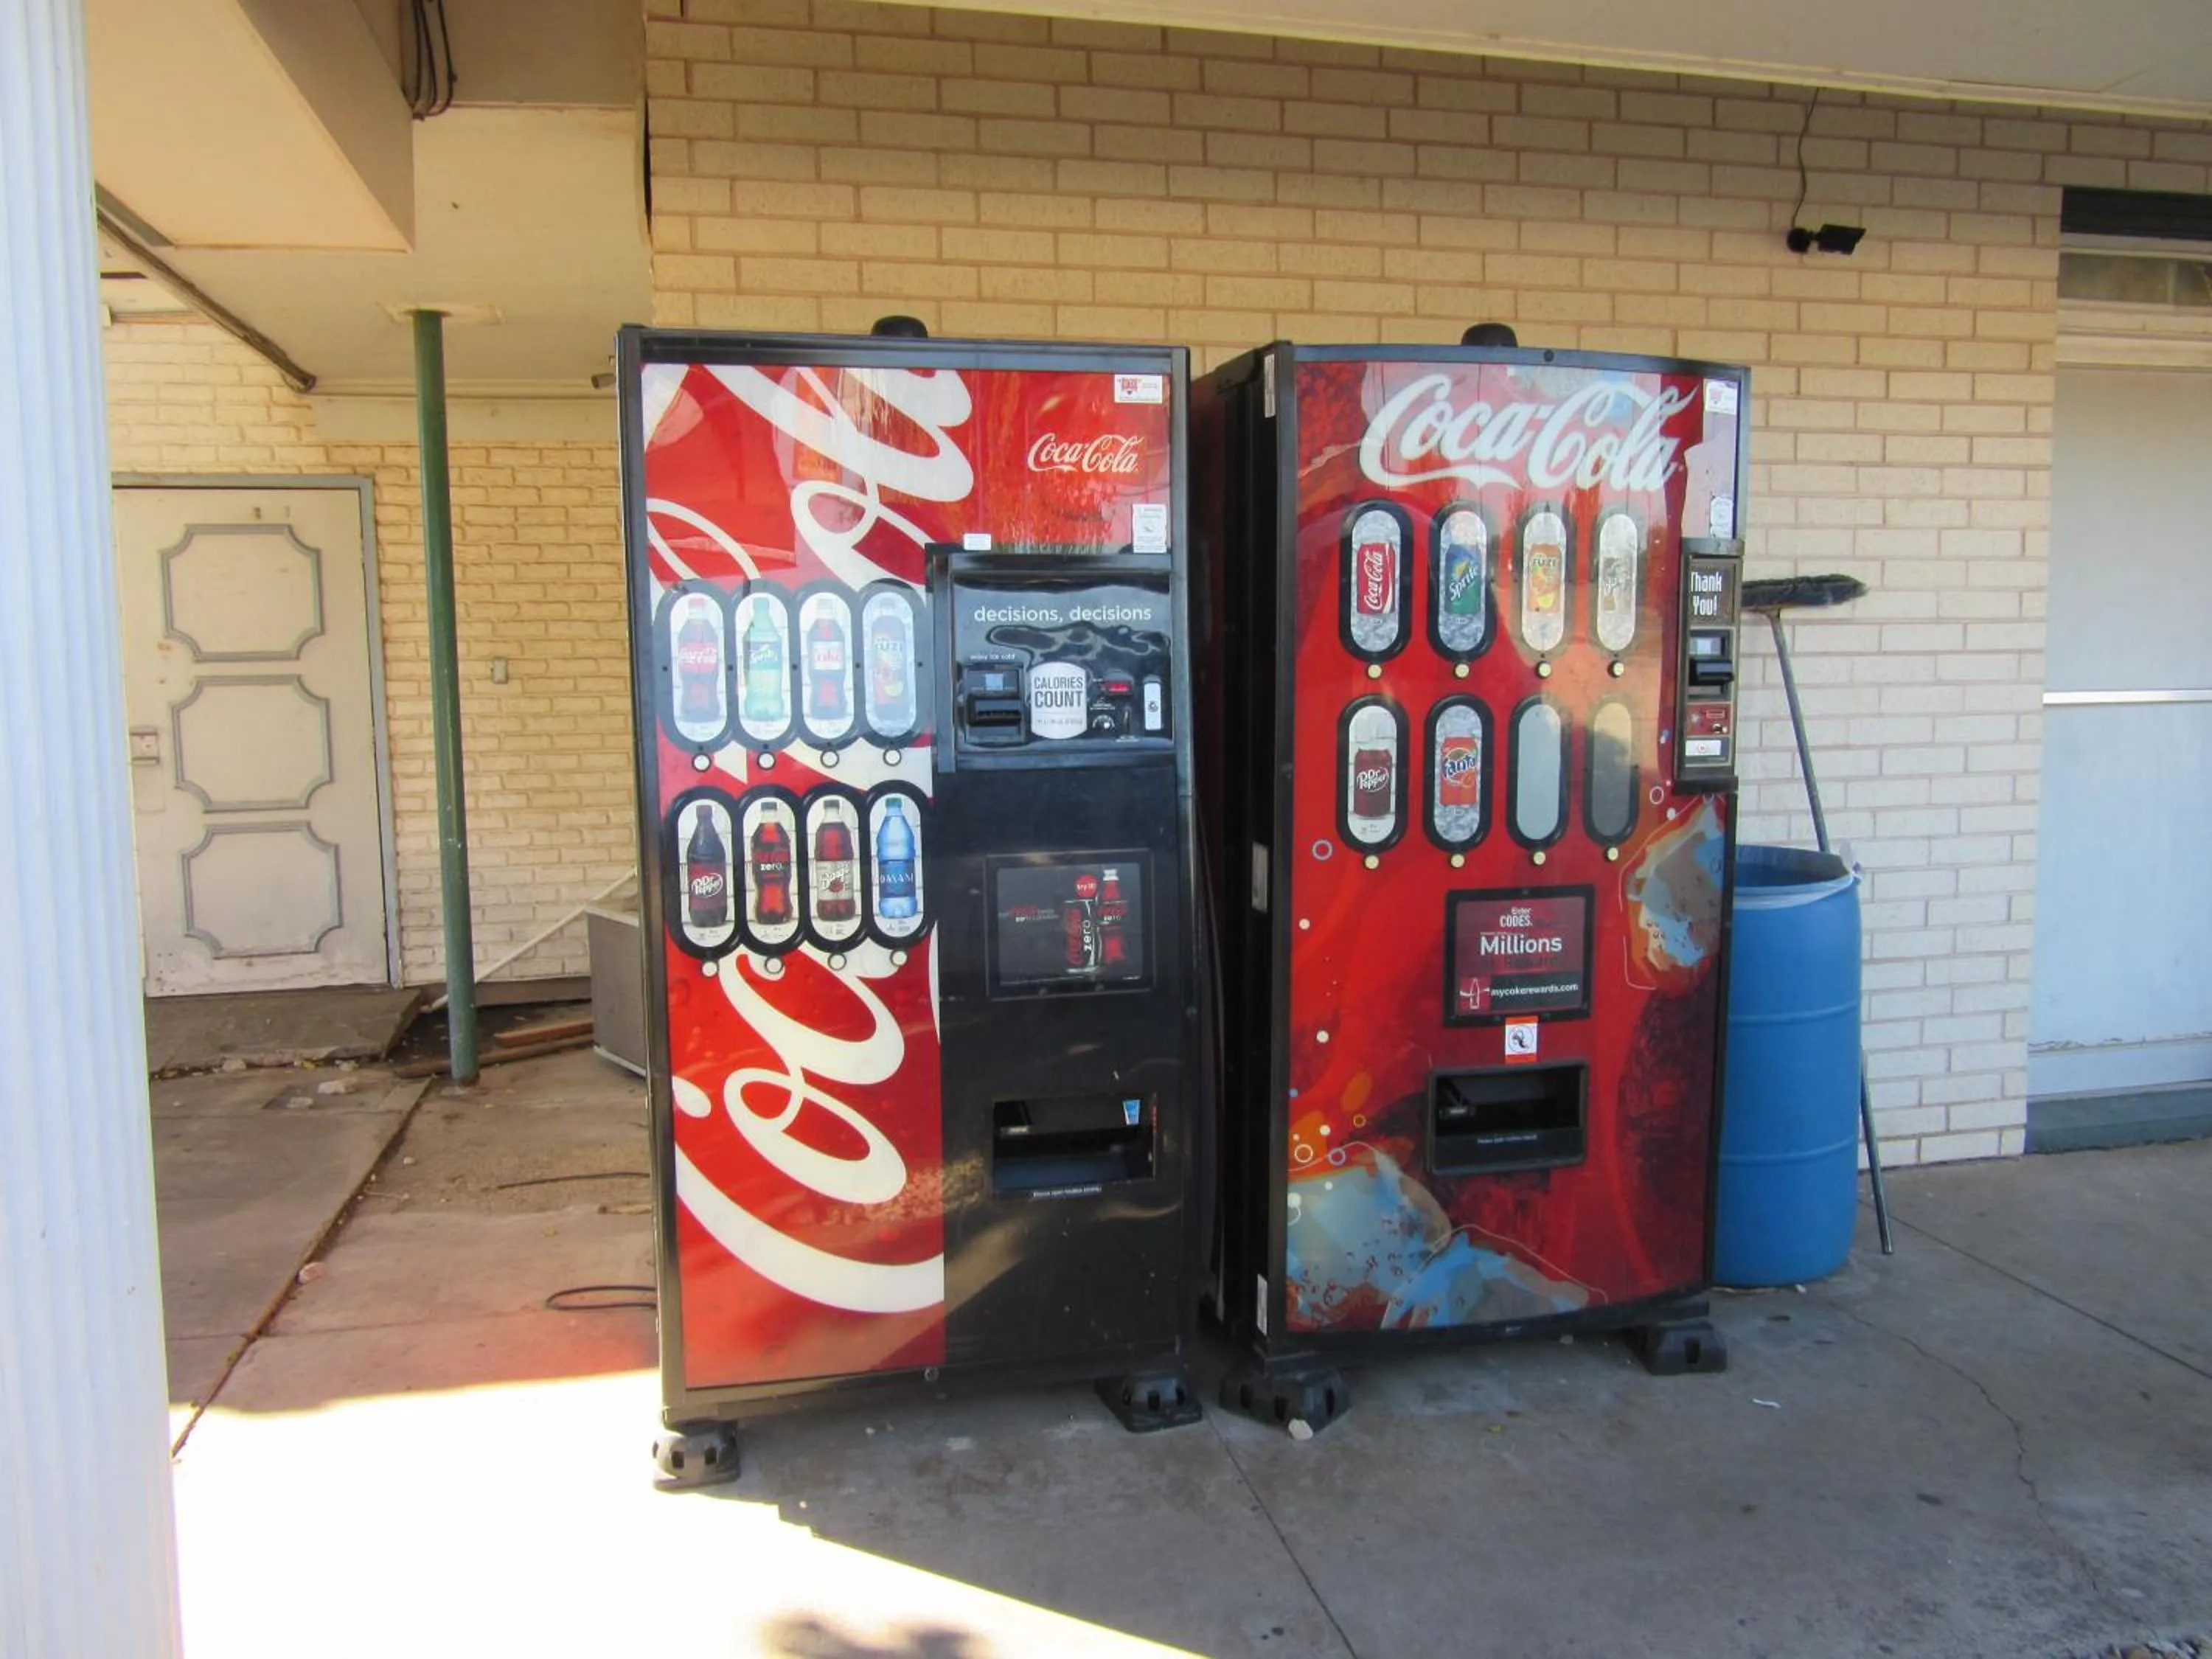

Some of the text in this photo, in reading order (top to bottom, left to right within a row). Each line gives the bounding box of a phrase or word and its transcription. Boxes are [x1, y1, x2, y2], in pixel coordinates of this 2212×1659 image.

[1359, 375, 1701, 490] Coca-Cola
[1027, 433, 1144, 473] Coca-Cola
[1363, 549, 1383, 611] Coca-Cola
[1449, 564, 1479, 602] Sprite
[1691, 571, 1722, 592] Thank
[973, 605, 1152, 623] decisions, decisions
[1692, 596, 1718, 616] You!
[1034, 675, 1084, 690] CALORIES
[1034, 691, 1083, 709] COUNT
[1082, 919, 1092, 952] zero
[1480, 934, 1562, 956] Millions
